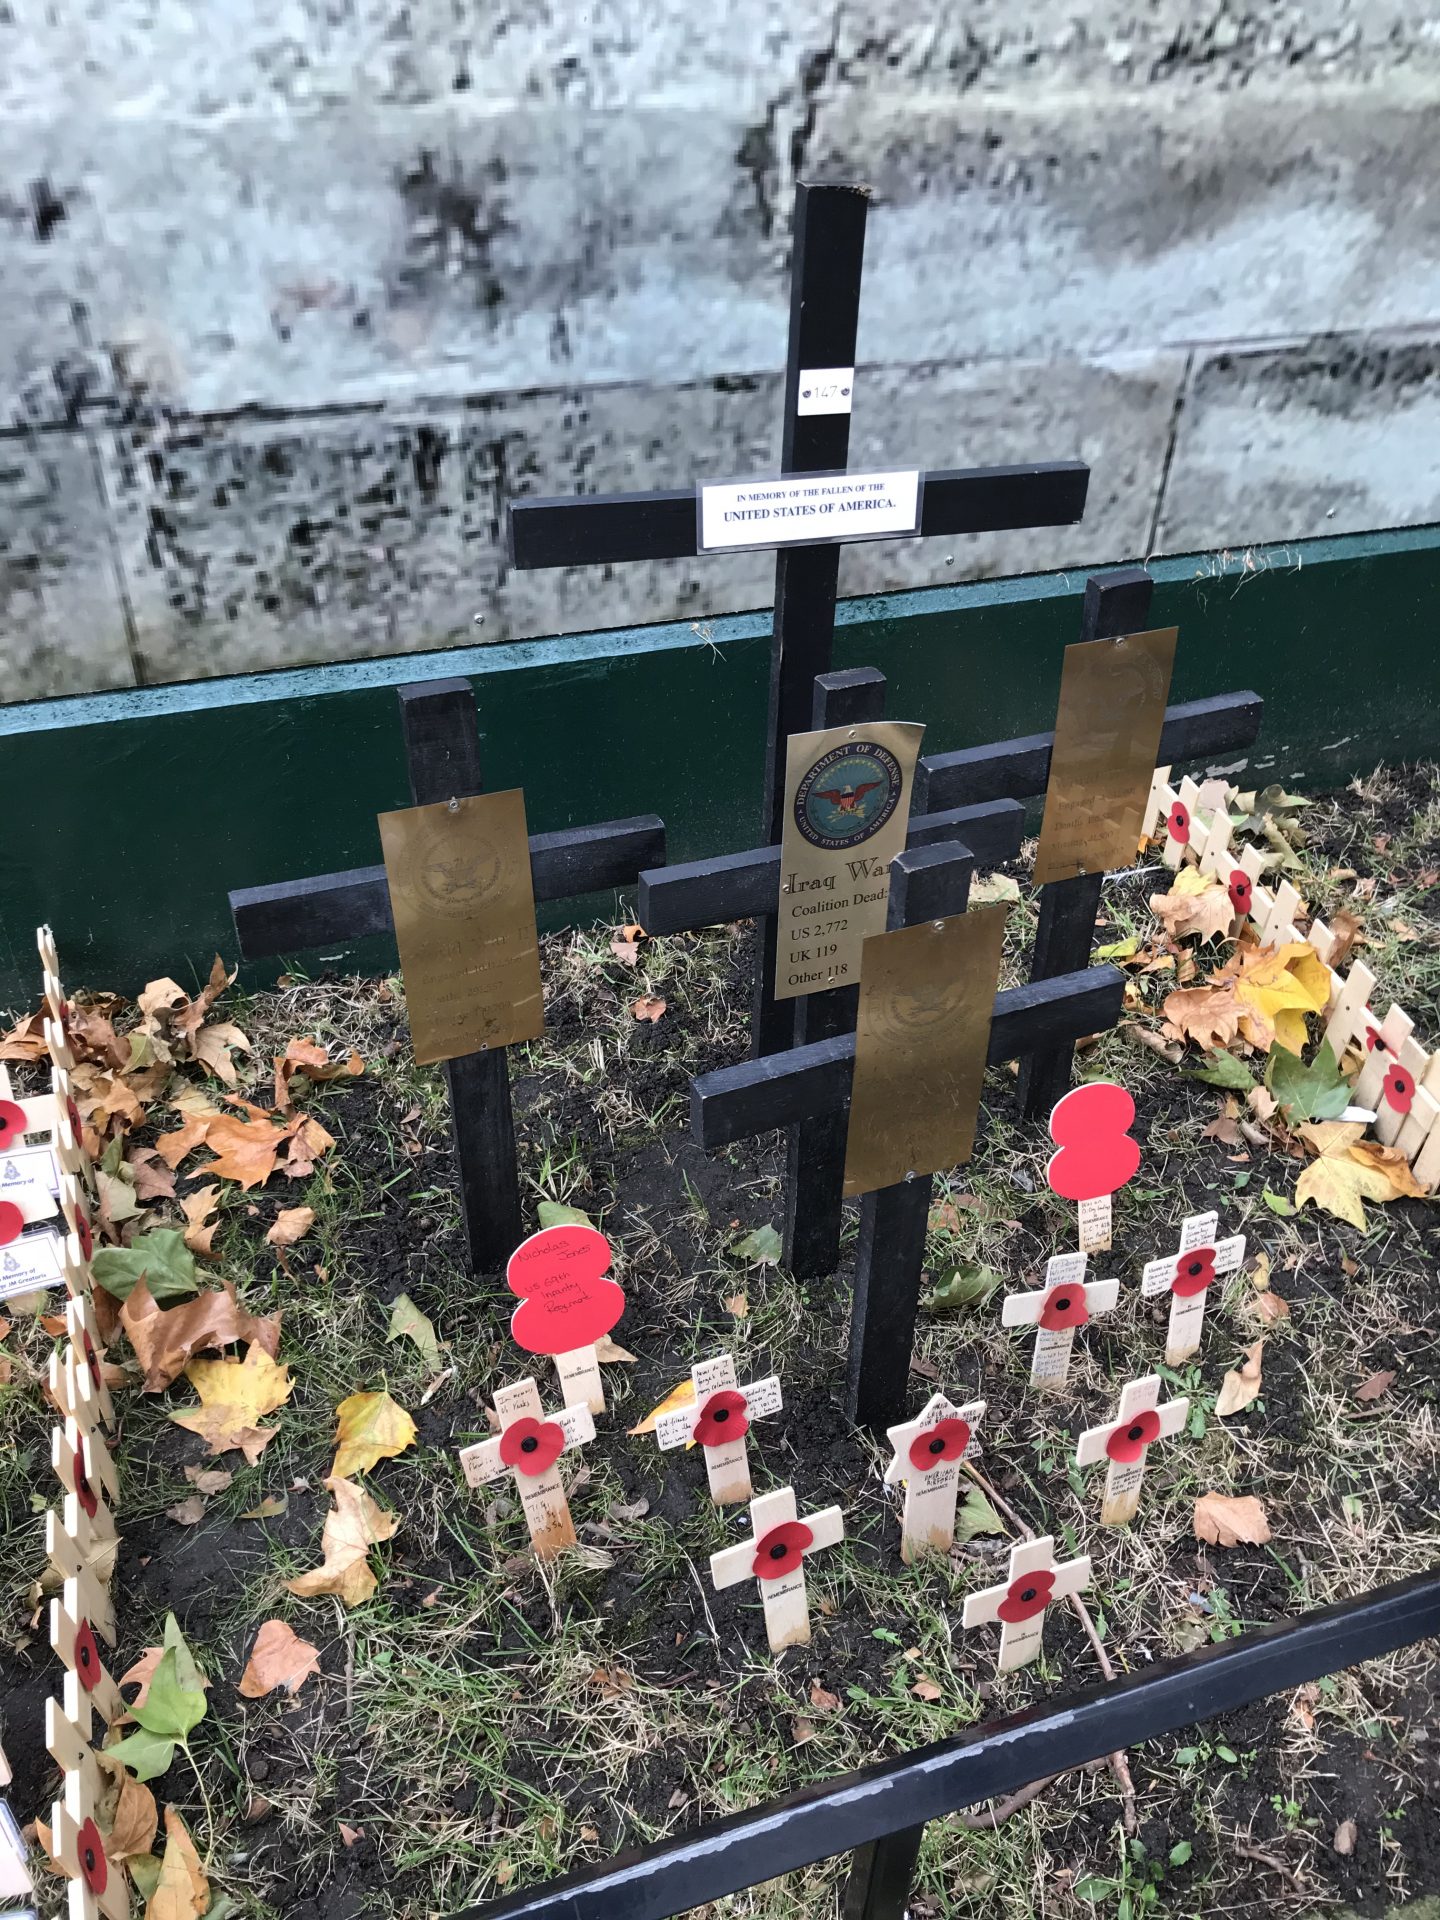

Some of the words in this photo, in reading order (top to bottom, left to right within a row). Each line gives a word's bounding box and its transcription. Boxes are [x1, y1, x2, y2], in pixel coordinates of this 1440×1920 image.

[813, 385, 838, 399] 147
[736, 494, 747, 503] IN
[748, 490, 788, 502] MEMORY
[789, 489, 801, 499] OF
[802, 488, 820, 497] THE
[821, 485, 854, 496] FALLEN
[855, 484, 867, 493] OF
[868, 483, 886, 492] THE
[723, 508, 771, 523] UNITED
[772, 505, 817, 518] STATES
[818, 503, 836, 515] OF
[837, 498, 897, 513] AMERICA.
[796, 745, 851, 806] DEPARTMENT
[856, 744, 873, 754] OF
[873, 749, 900, 787] DEFENSE
[800, 816, 819, 841] UNITED
[820, 838, 850, 847] STATES
[853, 833, 865, 842] OF
[869, 798, 896, 833] AMERICA
[785, 872, 837, 895] Iraq
[791, 898, 849, 918] Coalition
[853, 887, 889, 906] Dead:
[791, 927, 810, 941] US
[813, 919, 849, 937] 2,772
[789, 950, 811, 964] UK
[816, 943, 838, 959] 119
[788, 970, 824, 986] Other
[827, 963, 849, 977] 118
[1, 1179, 27, 1189] Memory
[517, 1240, 570, 1263] Nicholas
[2, 1270, 28, 1281] Memory
[563, 1366, 596, 1380] REMEMBRANCE
[710, 1455, 744, 1470] REMEMBRANCE
[524, 1483, 561, 1502] REMEMBRANCE
[915, 1483, 949, 1498] REMEMBRANCE
[767, 1583, 803, 1601] REMEMBRANCE
